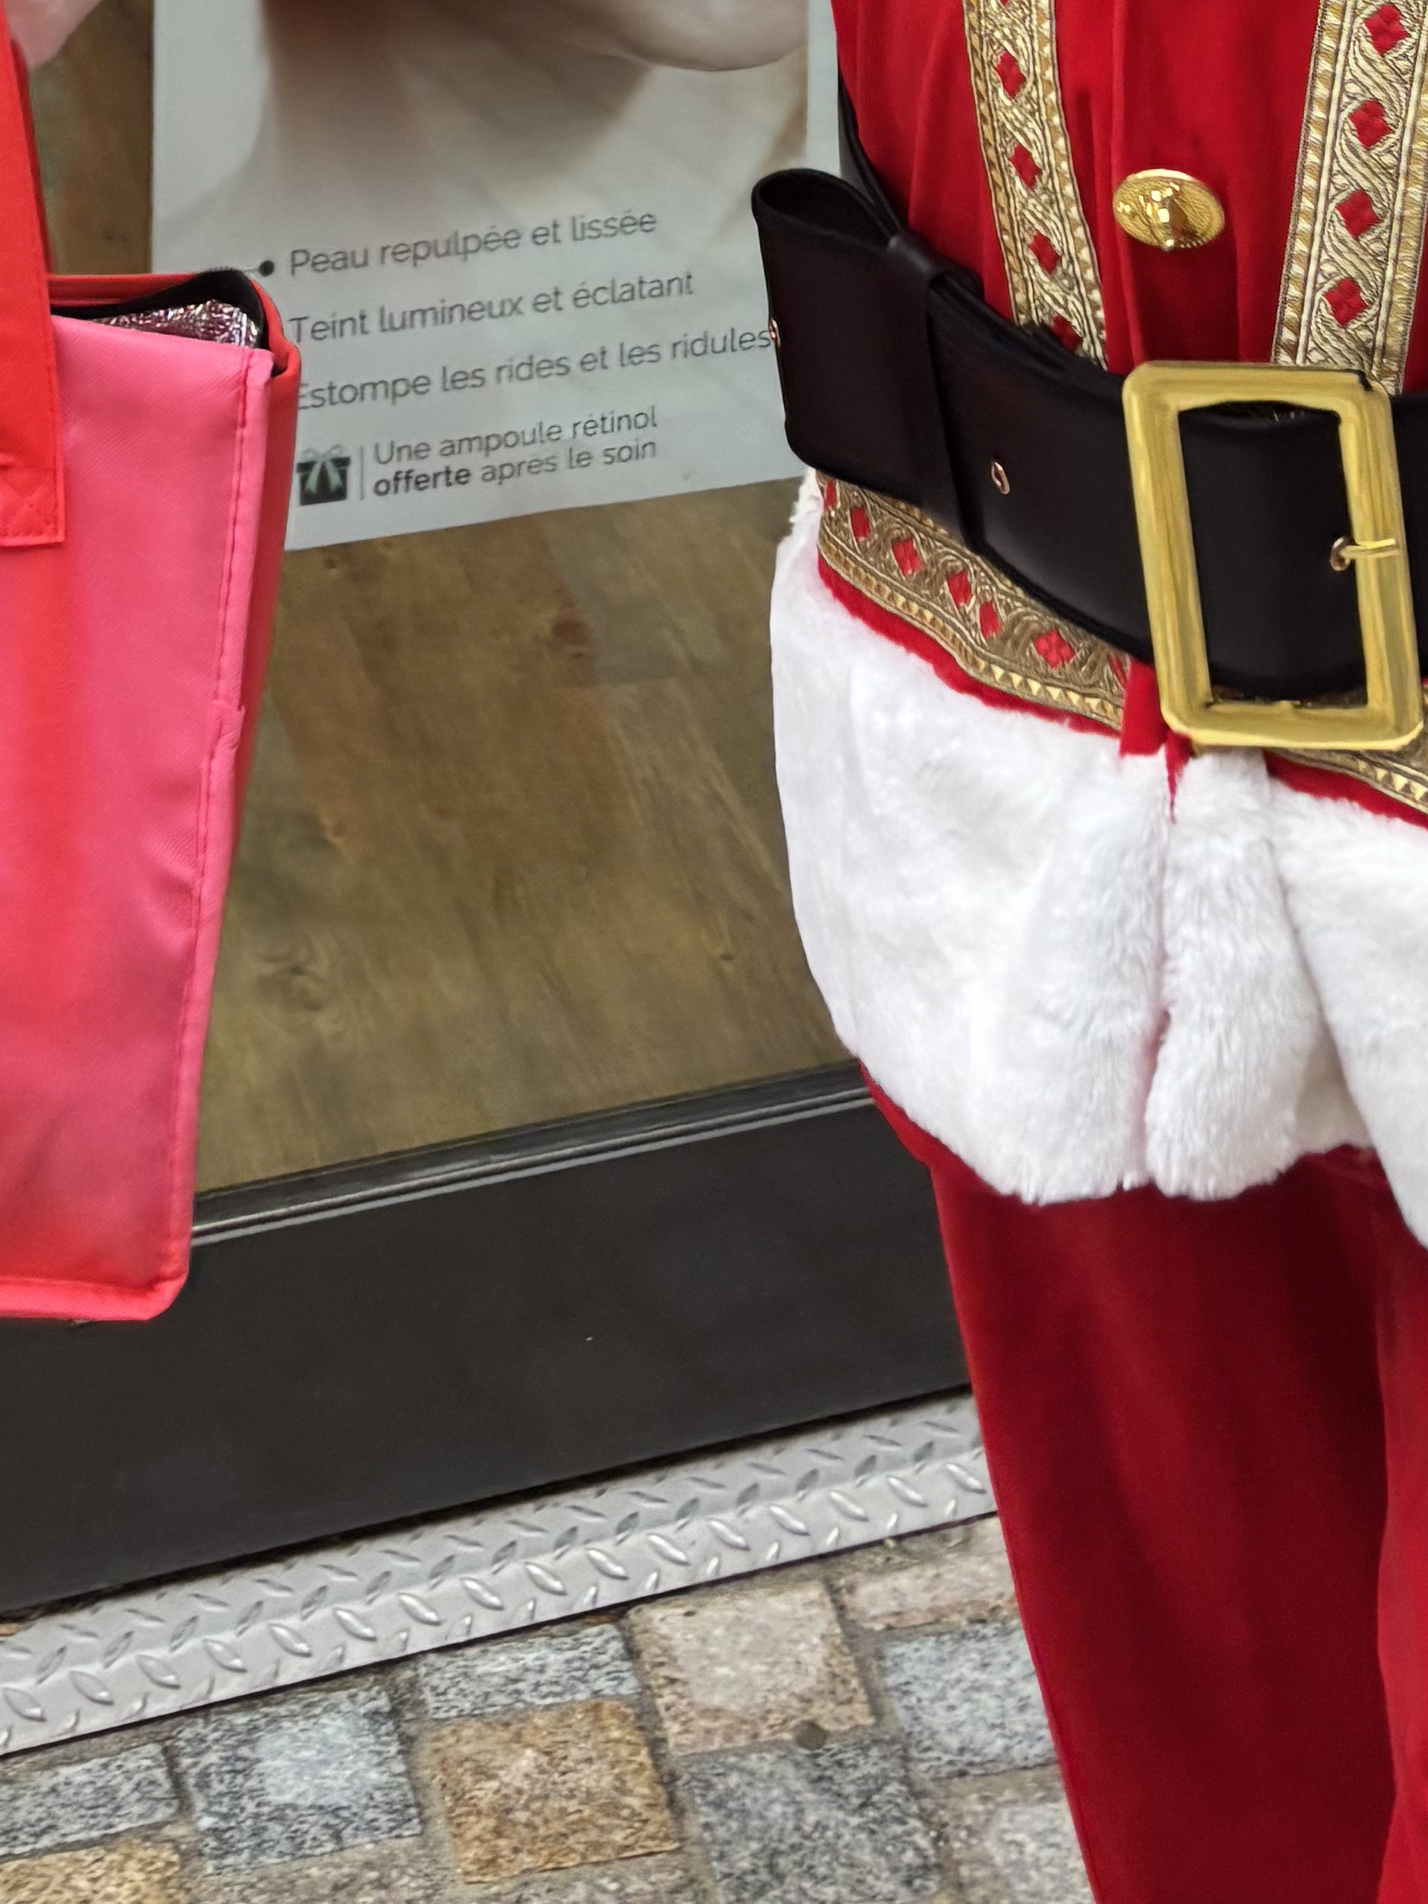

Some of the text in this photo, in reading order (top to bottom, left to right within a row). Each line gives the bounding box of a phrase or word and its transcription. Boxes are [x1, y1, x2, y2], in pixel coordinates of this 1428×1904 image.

[290, 210, 657, 278] Peau repulpée et lissée
[289, 271, 695, 343] Teint lumineux et éclatant
[296, 327, 772, 411] Estompe les rides et les ridules
[373, 438, 657, 498] offerte après le soin
[374, 406, 657, 466] Une ampoule rétinol
